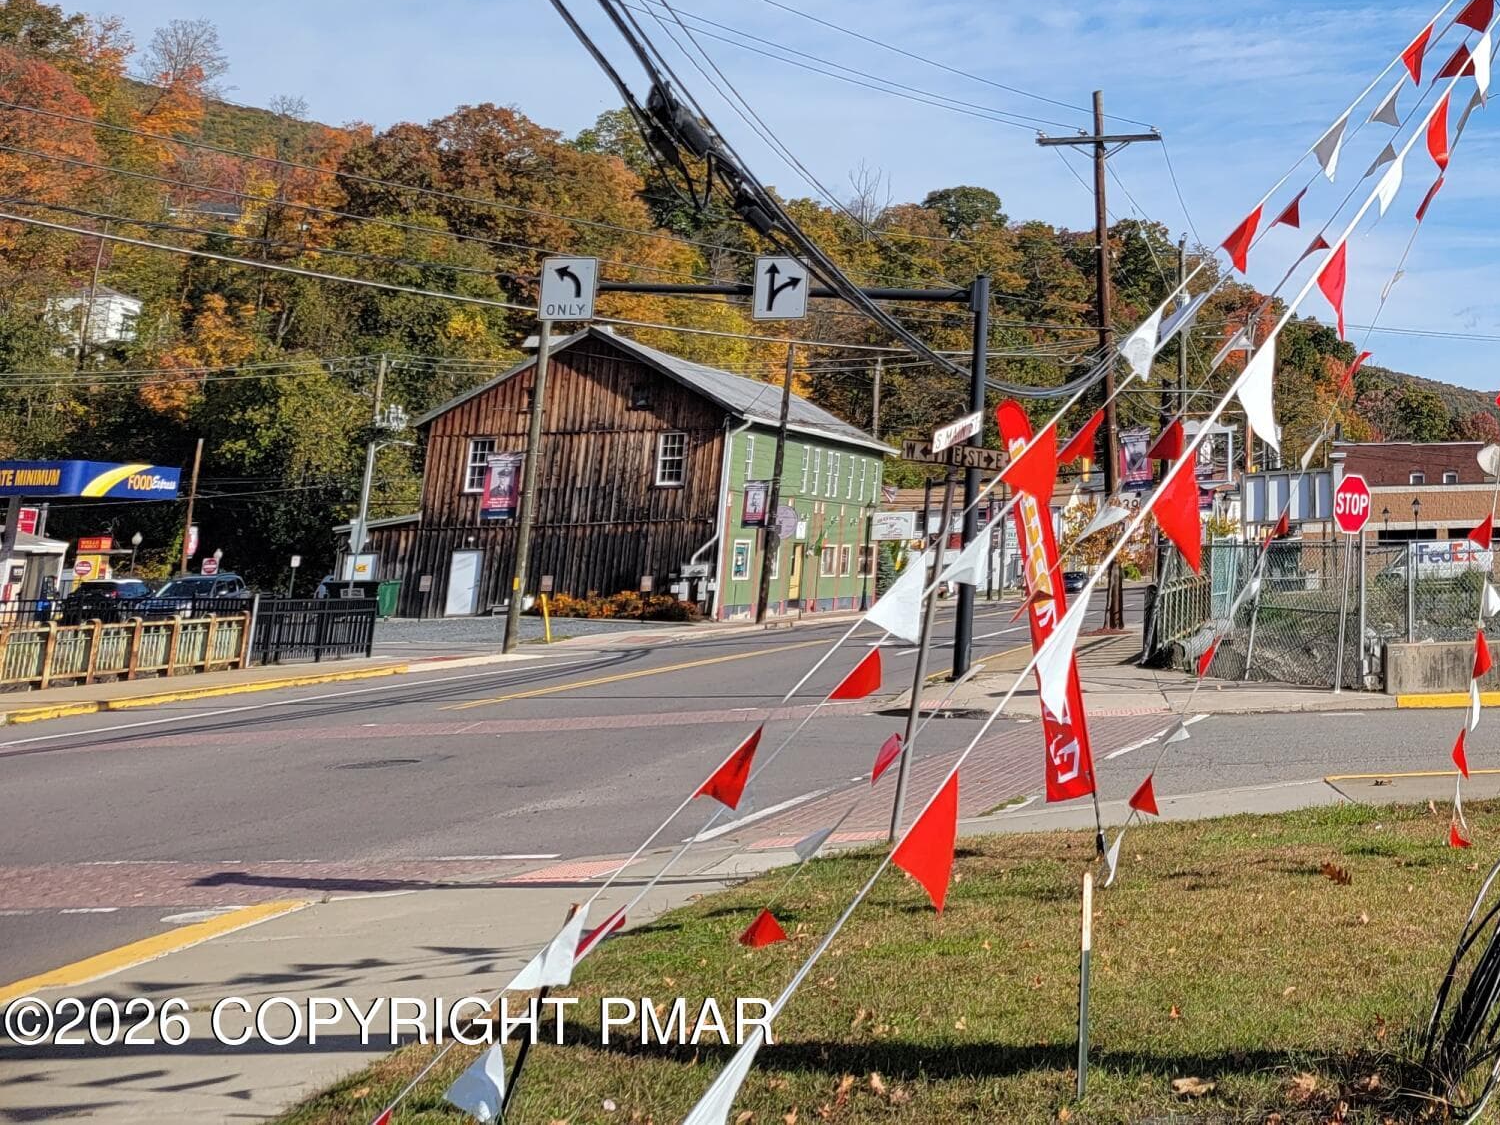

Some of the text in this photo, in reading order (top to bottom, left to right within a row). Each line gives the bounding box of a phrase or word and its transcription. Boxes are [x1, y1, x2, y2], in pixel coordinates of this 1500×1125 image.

[546, 304, 585, 316] ONLY
[936, 433, 942, 449] S
[968, 450, 983, 467] ST
[0, 469, 61, 486] TE MINIMUM
[128, 474, 152, 490] FOOD
[1336, 492, 1369, 515] STOP
[1418, 542, 1477, 564] FedEx
